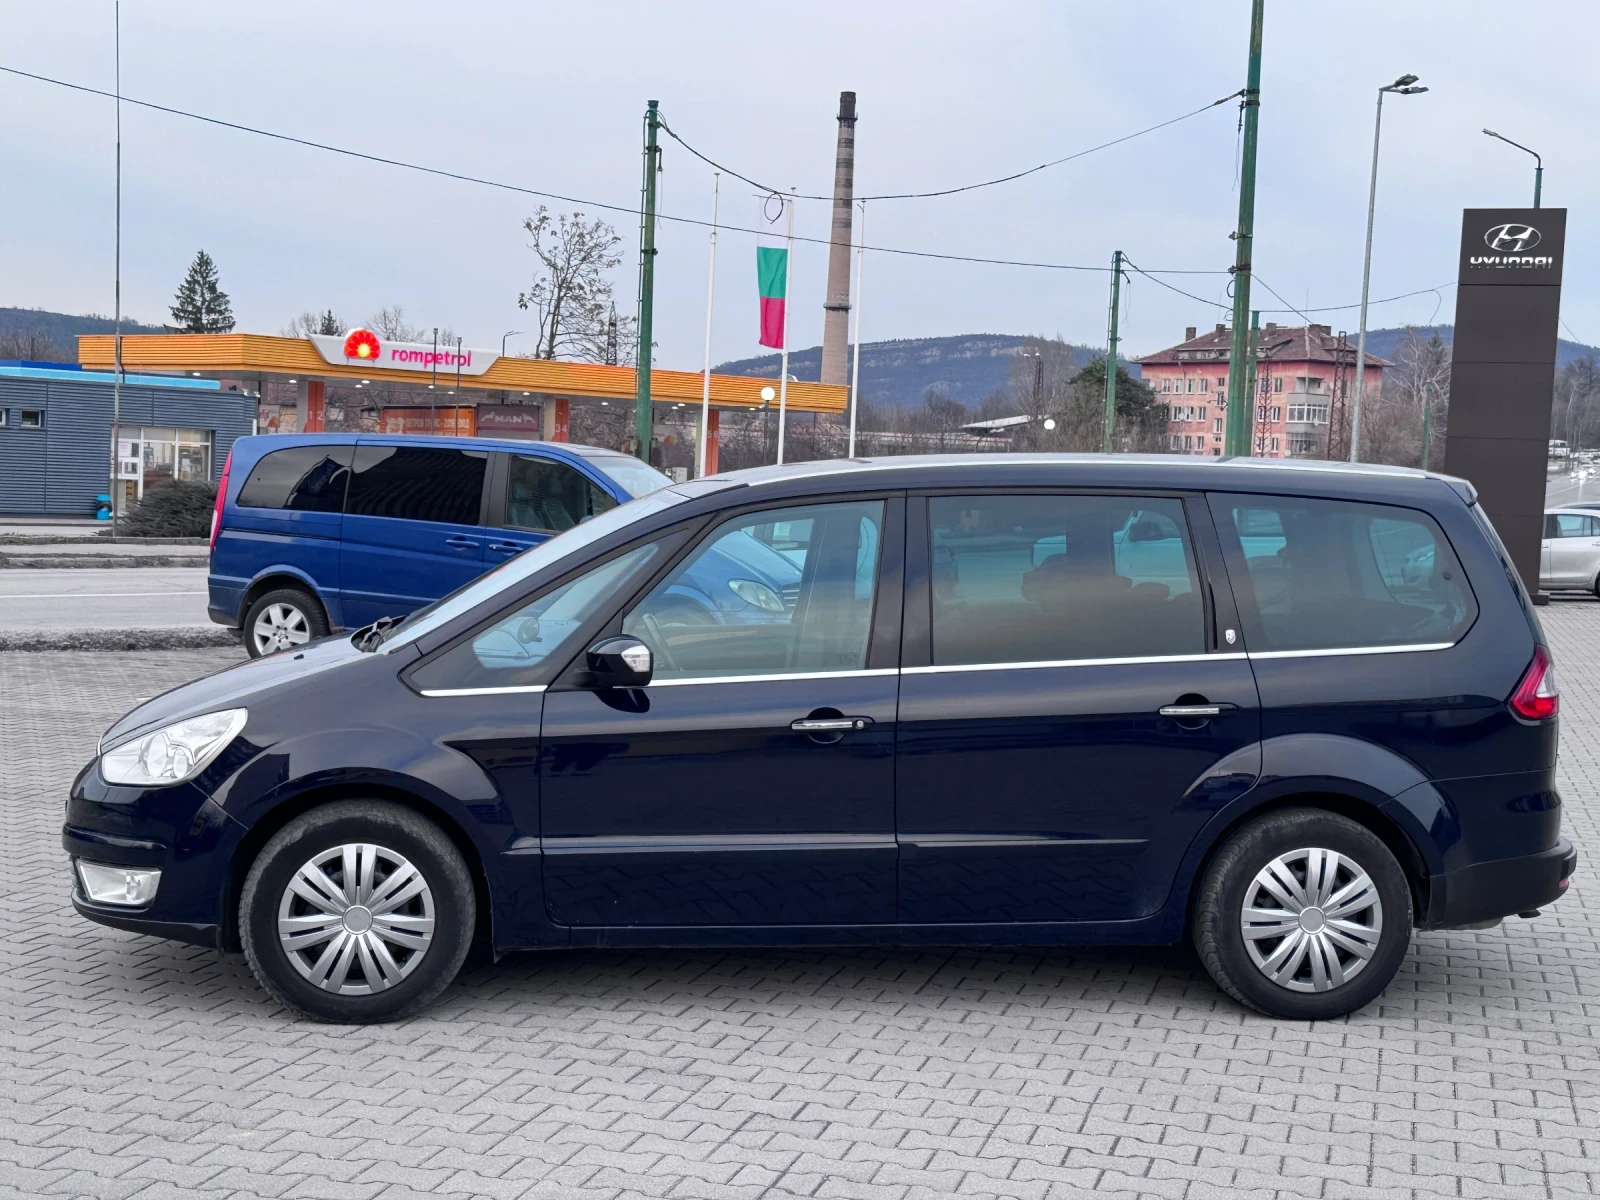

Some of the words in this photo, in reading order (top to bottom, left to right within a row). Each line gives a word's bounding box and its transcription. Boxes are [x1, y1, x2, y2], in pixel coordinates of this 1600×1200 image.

[1470, 256, 1552, 269] HYUNDAI
[391, 348, 472, 369] rompetrol
[317, 411, 323, 421] 2
[495, 415, 522, 423] MAN
[555, 424, 560, 432] 3
